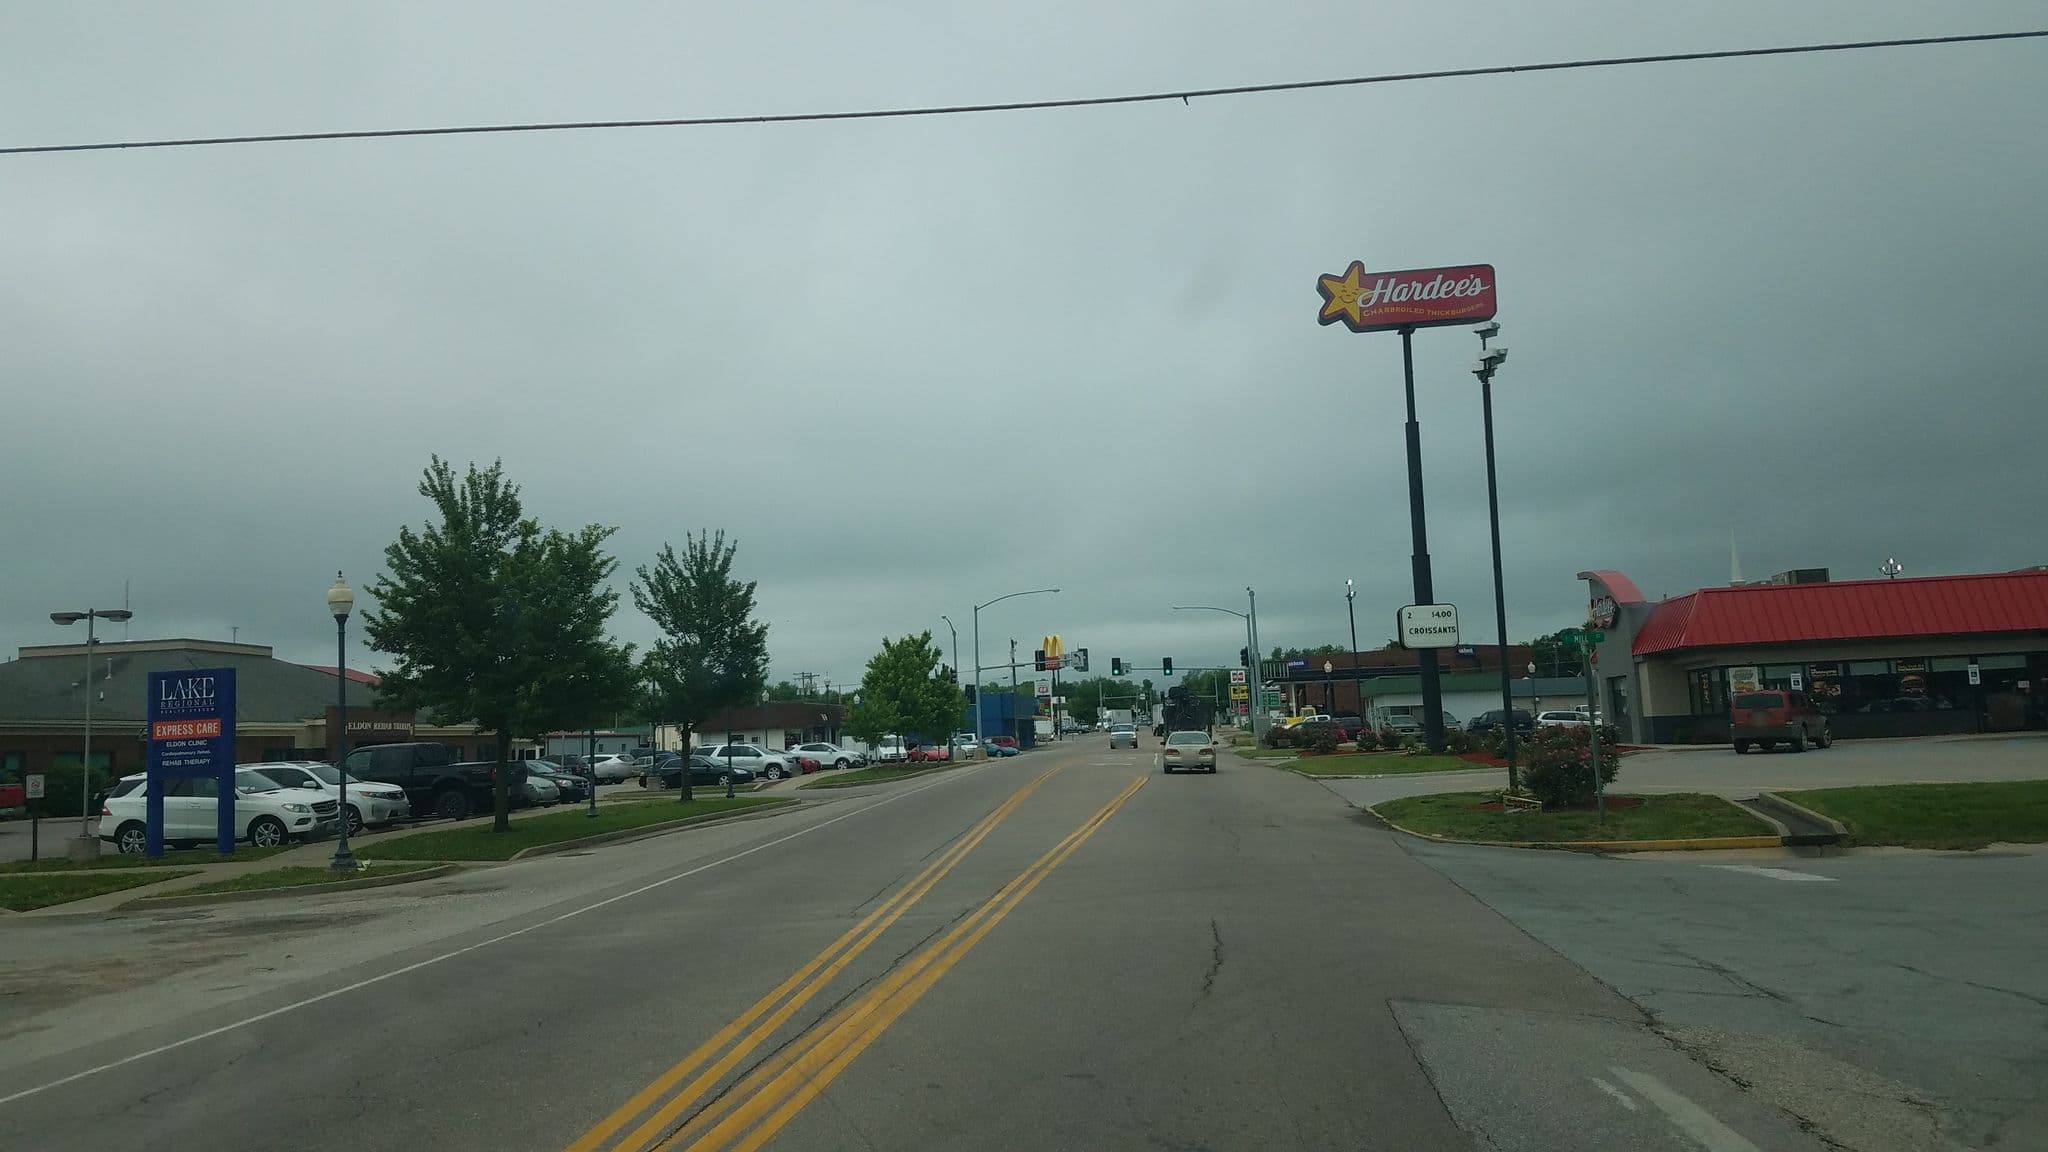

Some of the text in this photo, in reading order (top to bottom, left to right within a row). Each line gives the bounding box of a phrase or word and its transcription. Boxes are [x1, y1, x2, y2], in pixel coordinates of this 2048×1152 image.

[1357, 274, 1491, 308] Hardee's
[1363, 306, 1425, 317] CHARBROILED
[1409, 626, 1456, 635] CROISSANTS
[161, 677, 215, 700] LAKE
[160, 699, 215, 708] REGIONAL
[156, 722, 218, 736] EXPRESS CARE
[348, 722, 372, 730] ELDON
